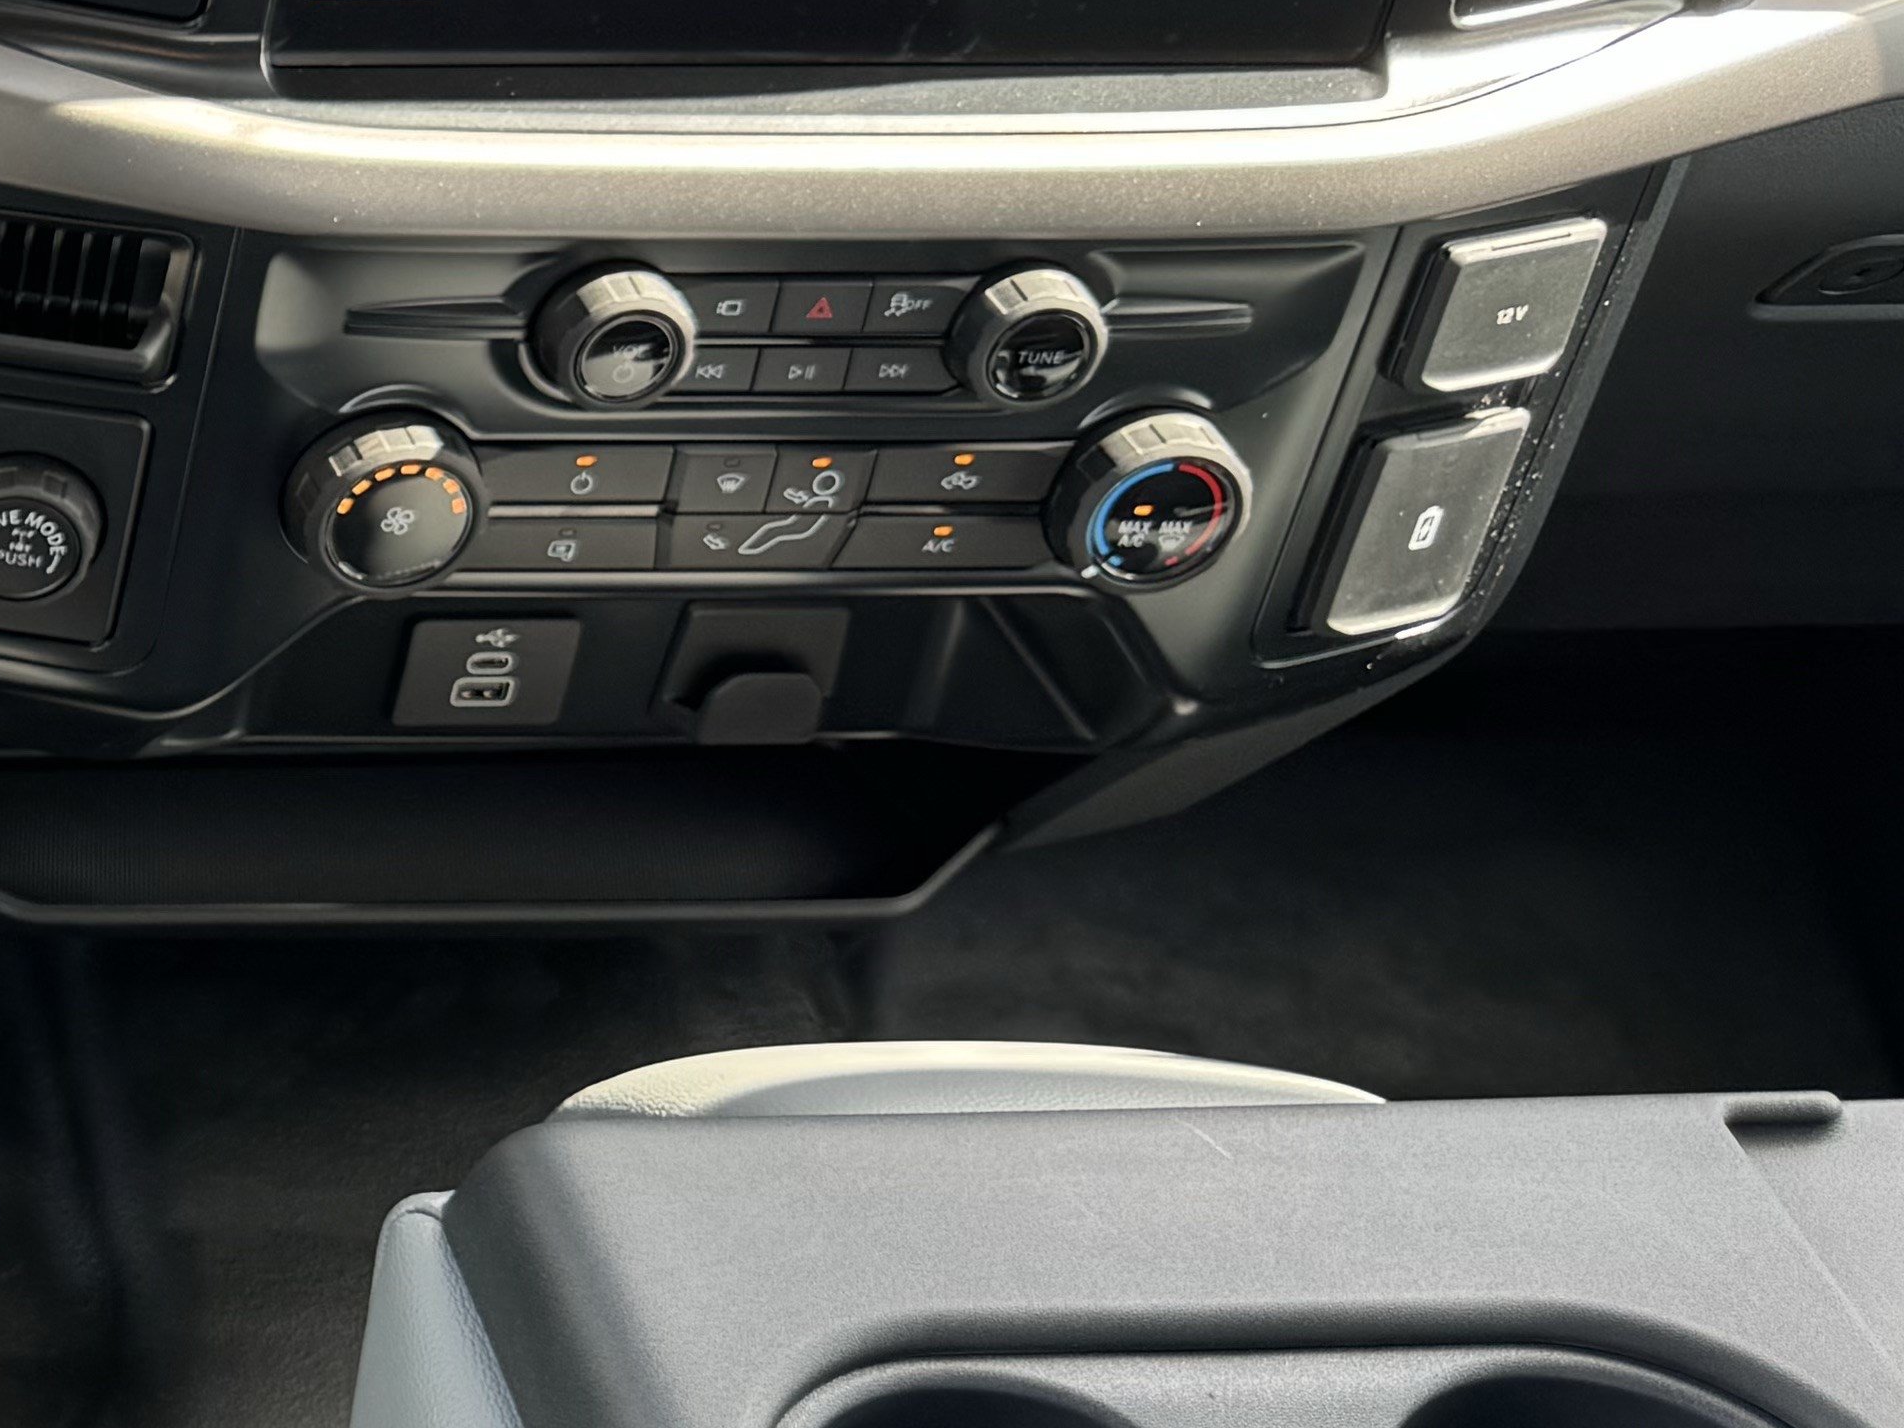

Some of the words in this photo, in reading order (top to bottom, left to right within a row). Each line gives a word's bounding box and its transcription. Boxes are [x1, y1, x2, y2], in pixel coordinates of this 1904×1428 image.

[1019, 349, 1066, 365] TUNE
[25, 511, 68, 556] MODE
[1118, 521, 1152, 535] MAX
[1158, 521, 1192, 535] MAX
[923, 539, 955, 554] A/C
[1118, 535, 1145, 548] A/C
